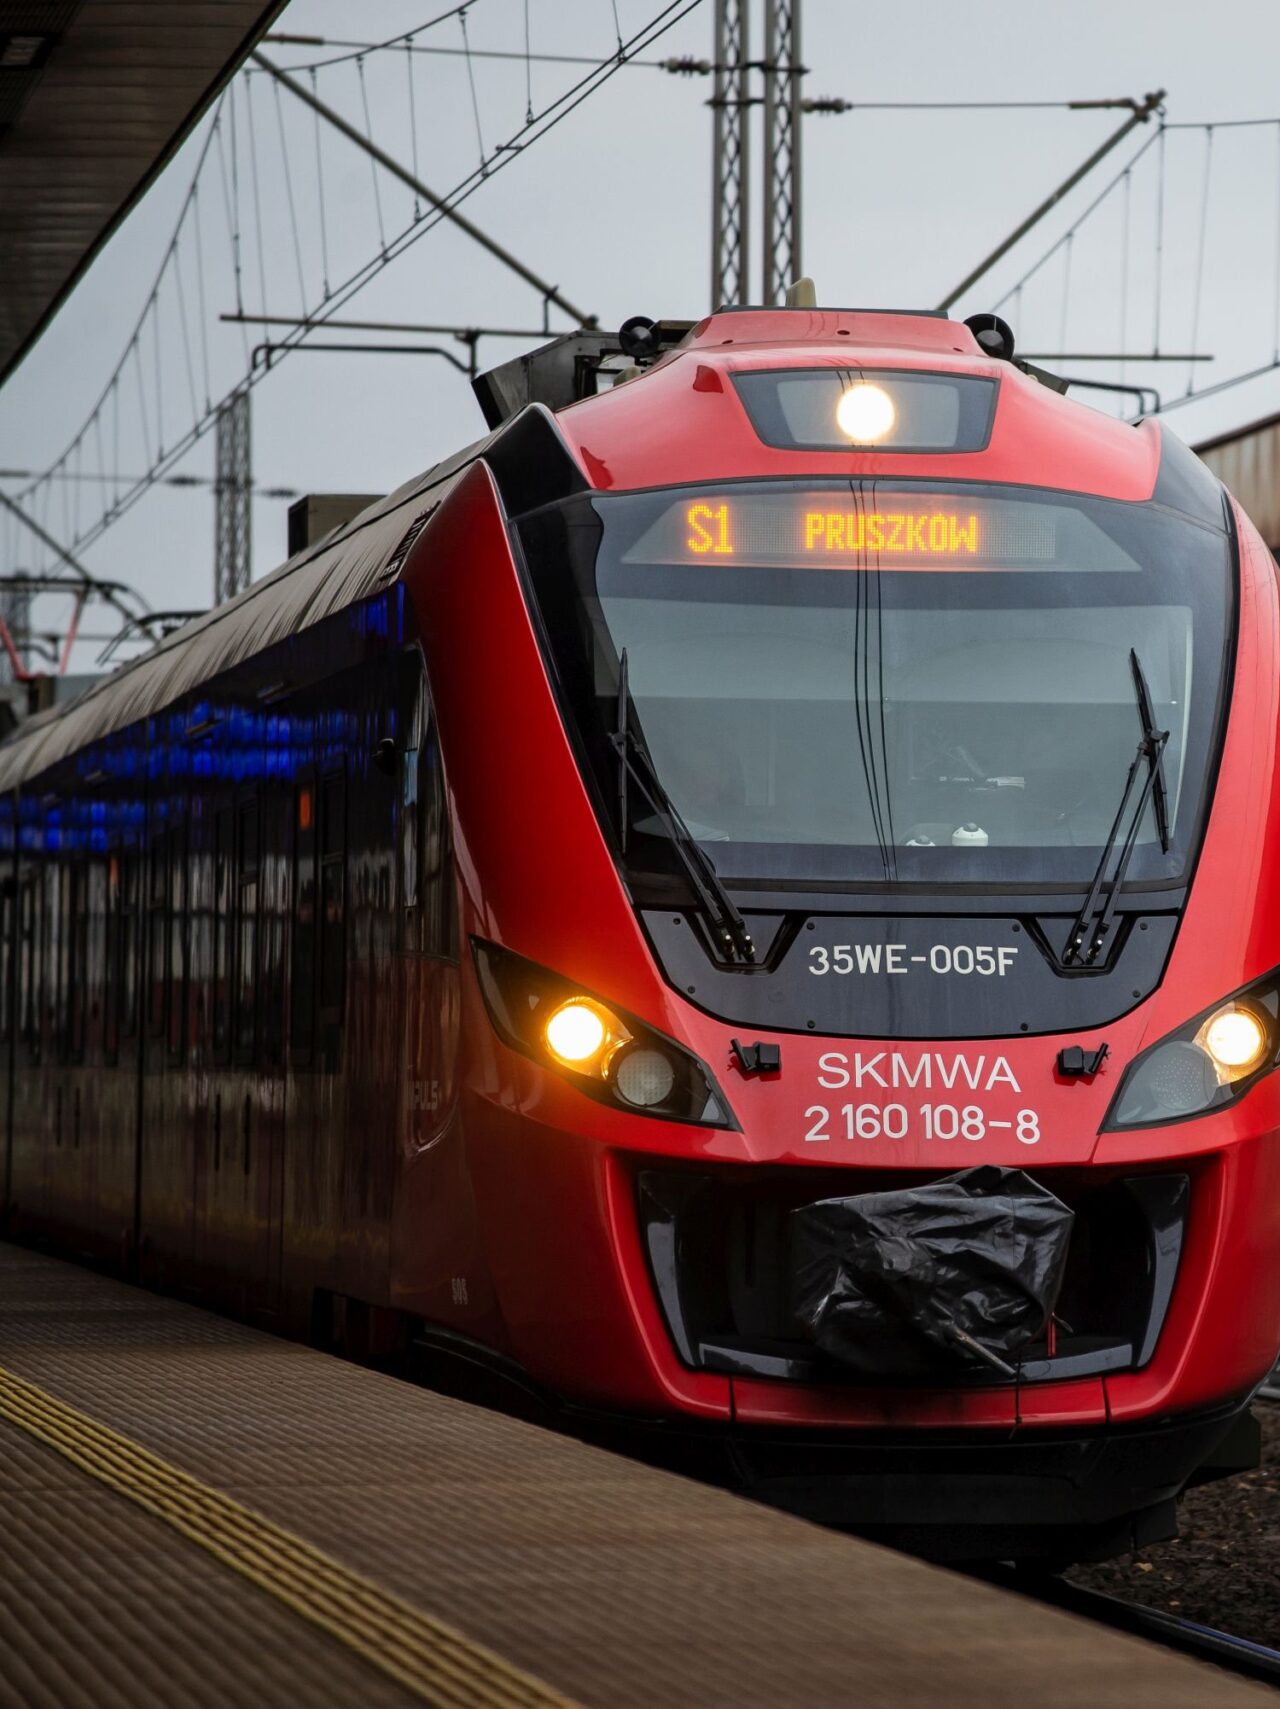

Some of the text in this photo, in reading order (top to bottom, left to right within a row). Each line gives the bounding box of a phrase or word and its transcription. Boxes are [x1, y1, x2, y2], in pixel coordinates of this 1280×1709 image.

[686, 503, 734, 554] S1
[808, 943, 1019, 977] 35WE-005F
[816, 1051, 1022, 1093] SKMWA
[803, 1103, 1041, 1145] 2 160 108-8
